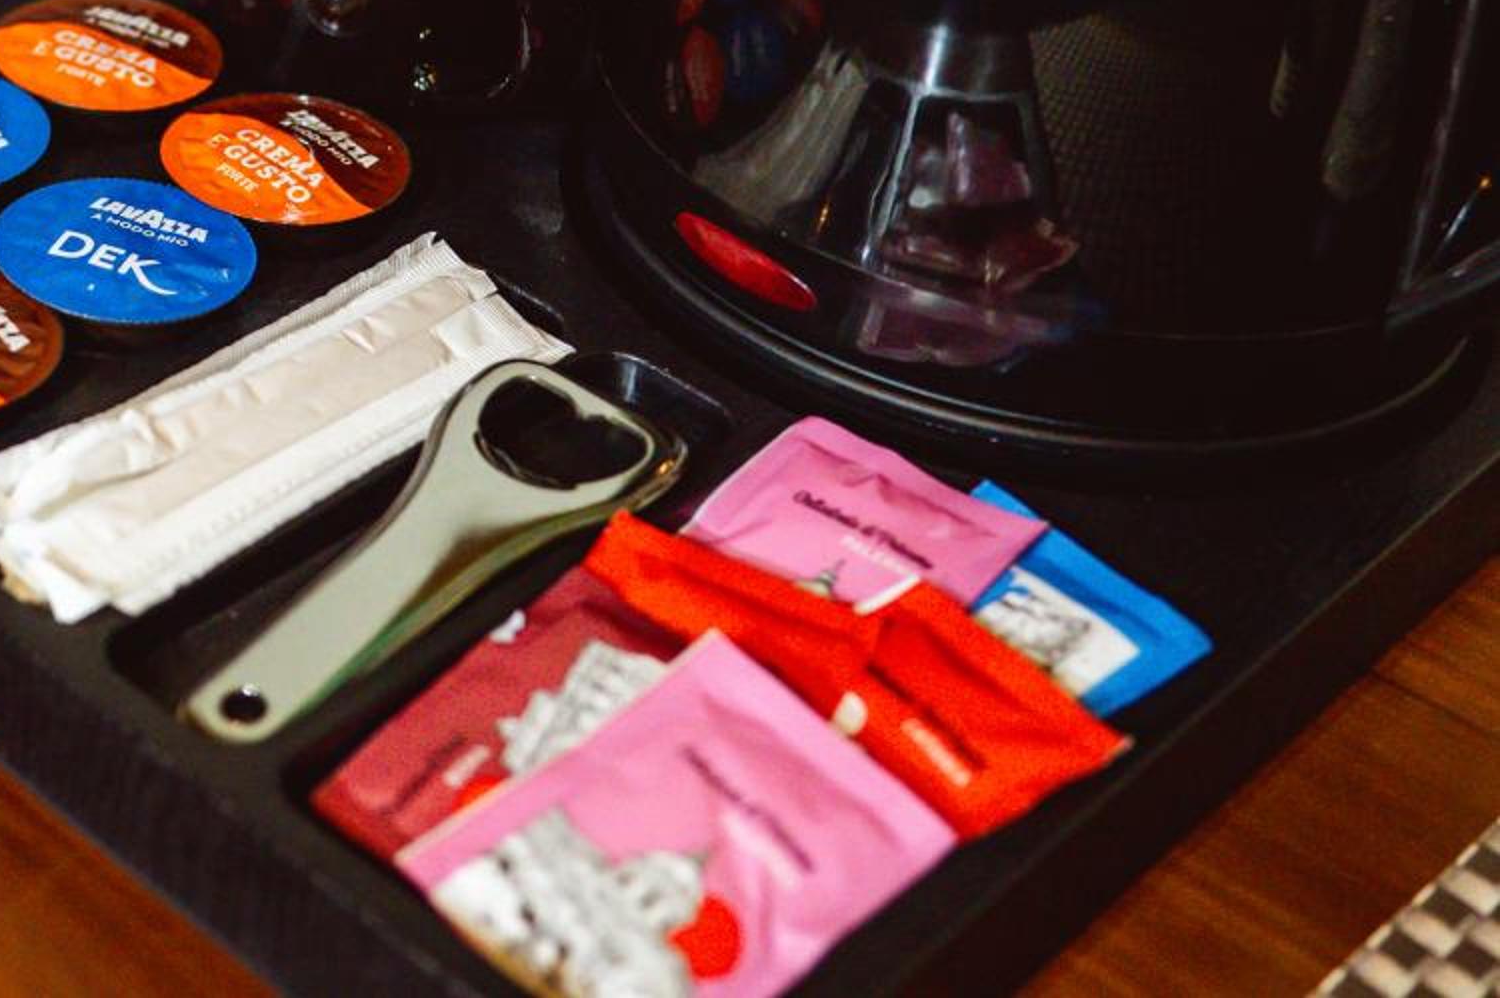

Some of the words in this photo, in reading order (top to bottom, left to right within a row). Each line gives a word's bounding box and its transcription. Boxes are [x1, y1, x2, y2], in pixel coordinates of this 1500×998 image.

[53, 29, 157, 74] CREMA
[54, 45, 156, 89] GUSTO
[223, 144, 313, 204] GUSTO
[236, 129, 325, 188] CREMA
[89, 197, 209, 244] LAVAZZA
[105, 215, 157, 239] MODO
[157, 233, 190, 248] MIO
[47, 230, 180, 296] DEK
